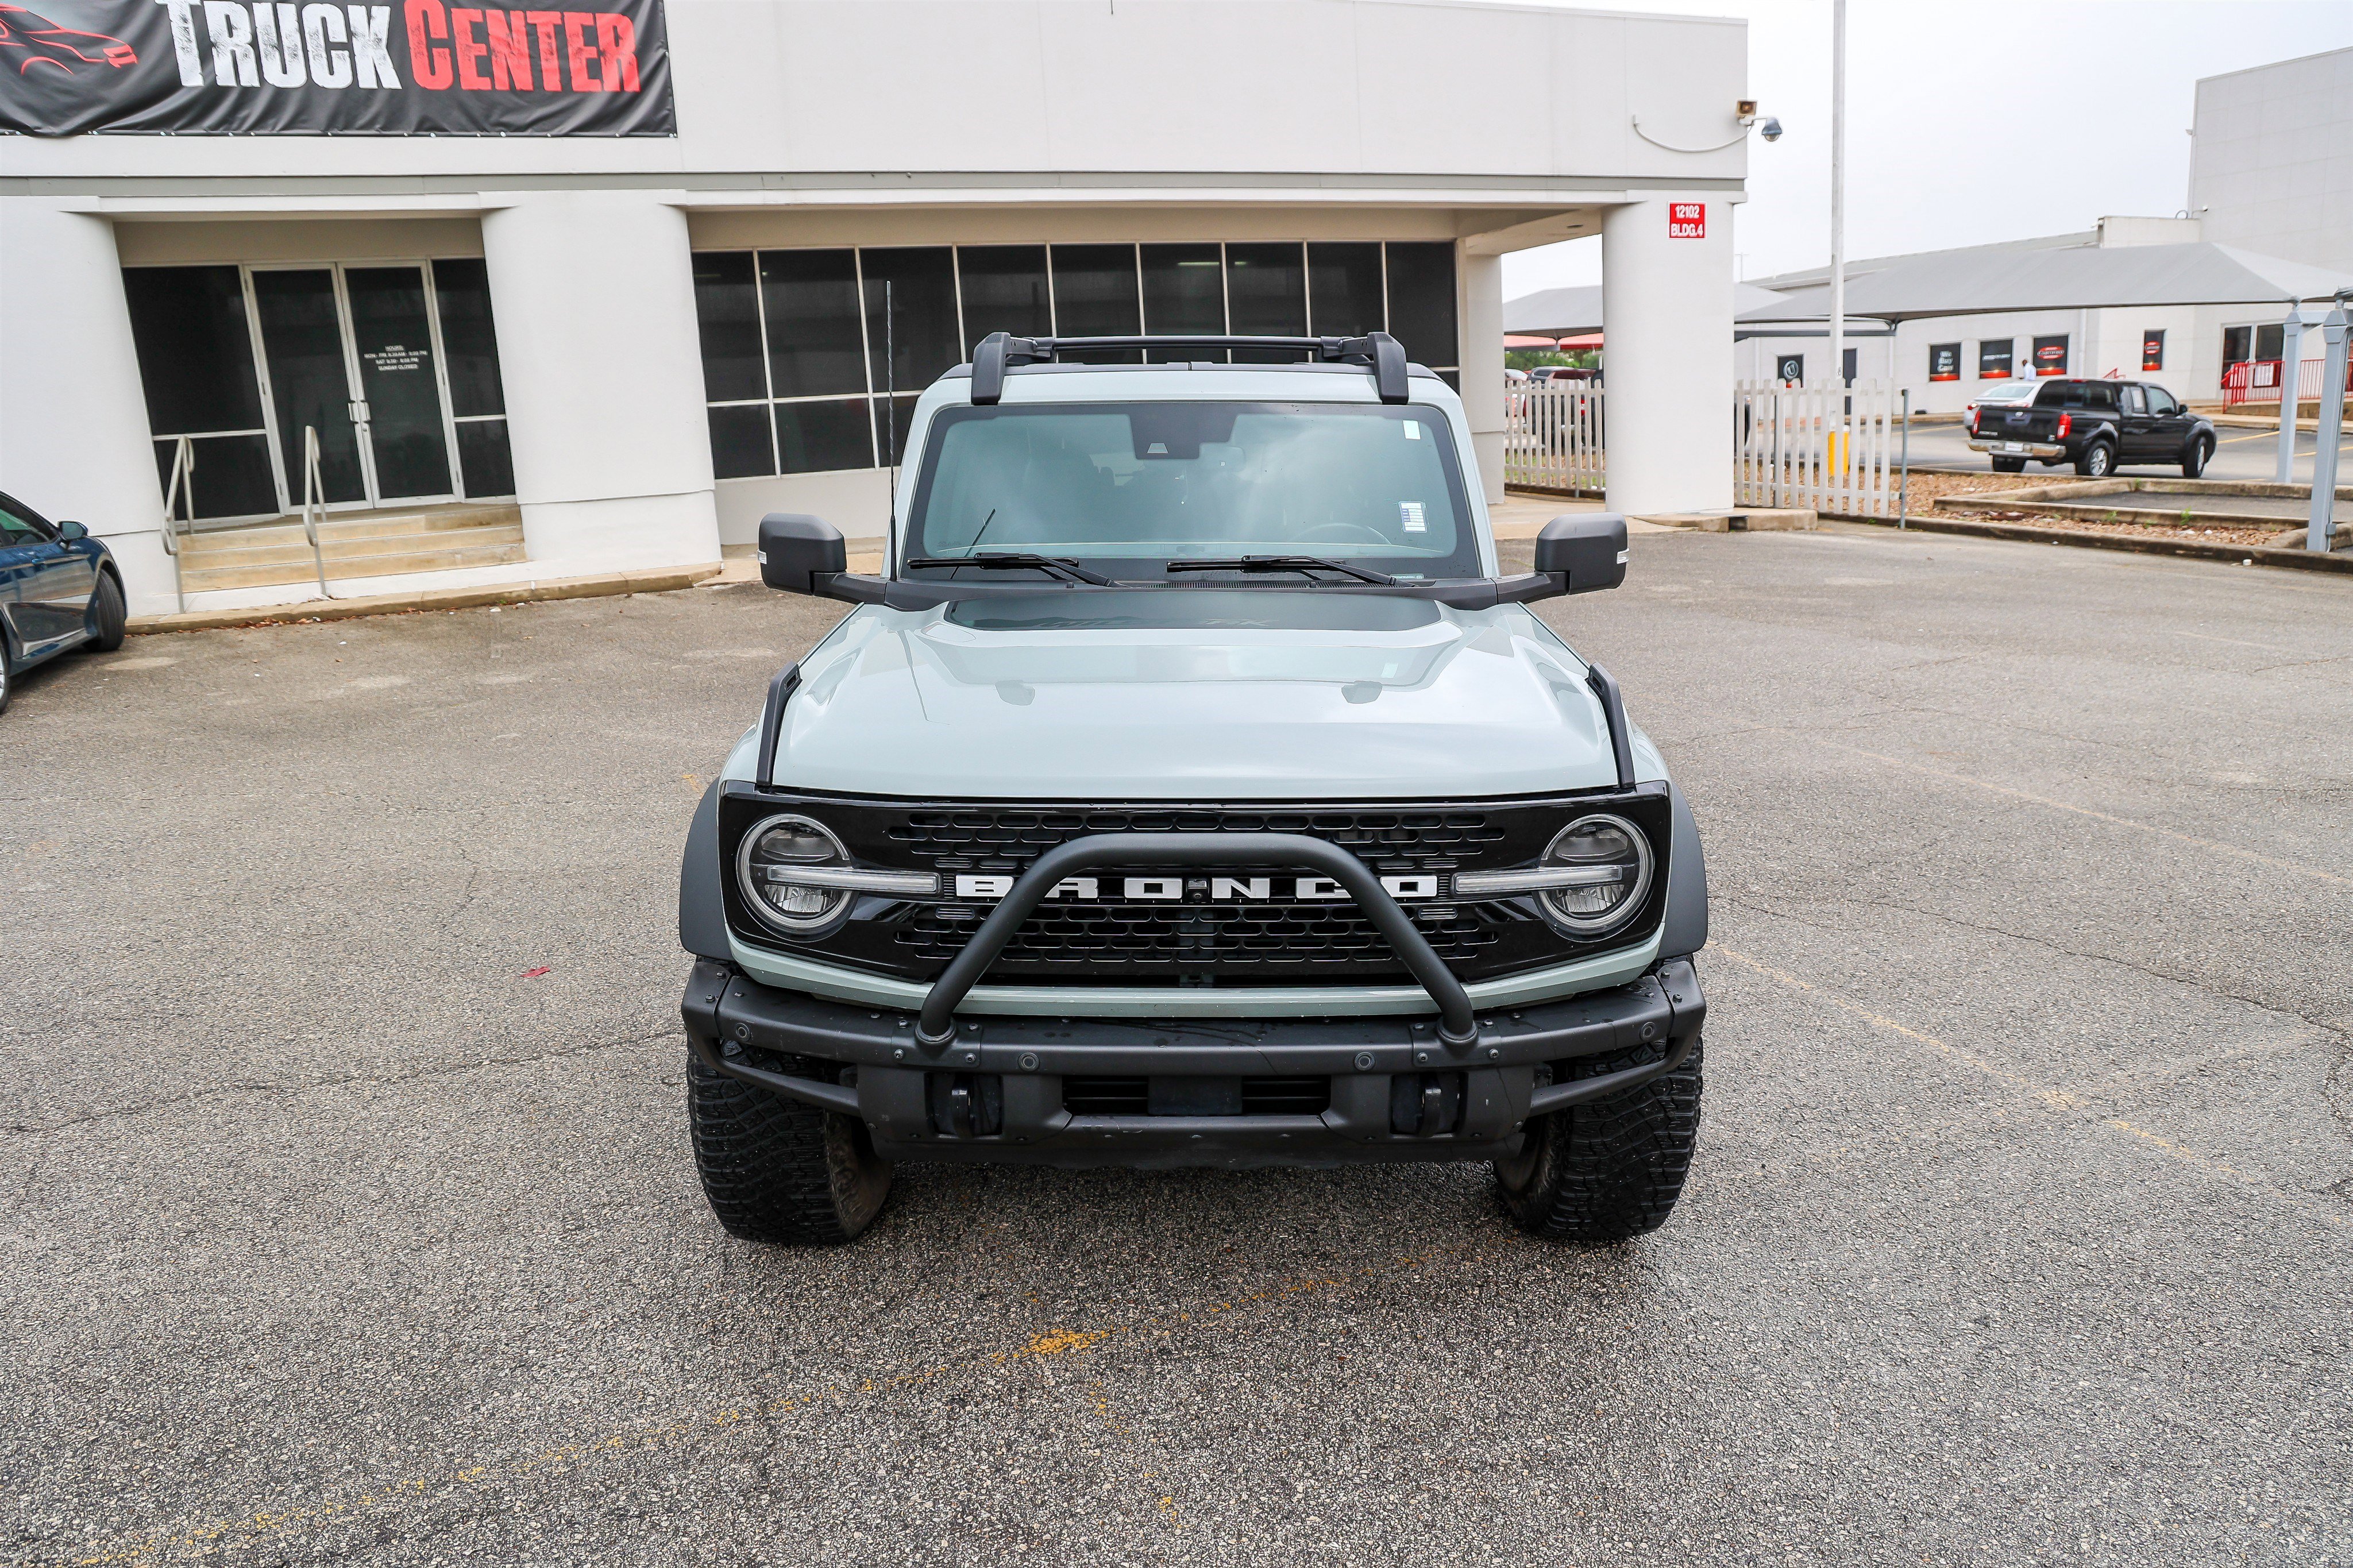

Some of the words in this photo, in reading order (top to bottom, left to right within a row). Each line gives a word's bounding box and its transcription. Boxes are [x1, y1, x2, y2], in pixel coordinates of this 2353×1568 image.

[154, 0, 402, 89] TRUCK
[404, 0, 640, 92] CENTER
[1675, 205, 1699, 219] 12102
[955, 875, 1438, 899] BRONCO
